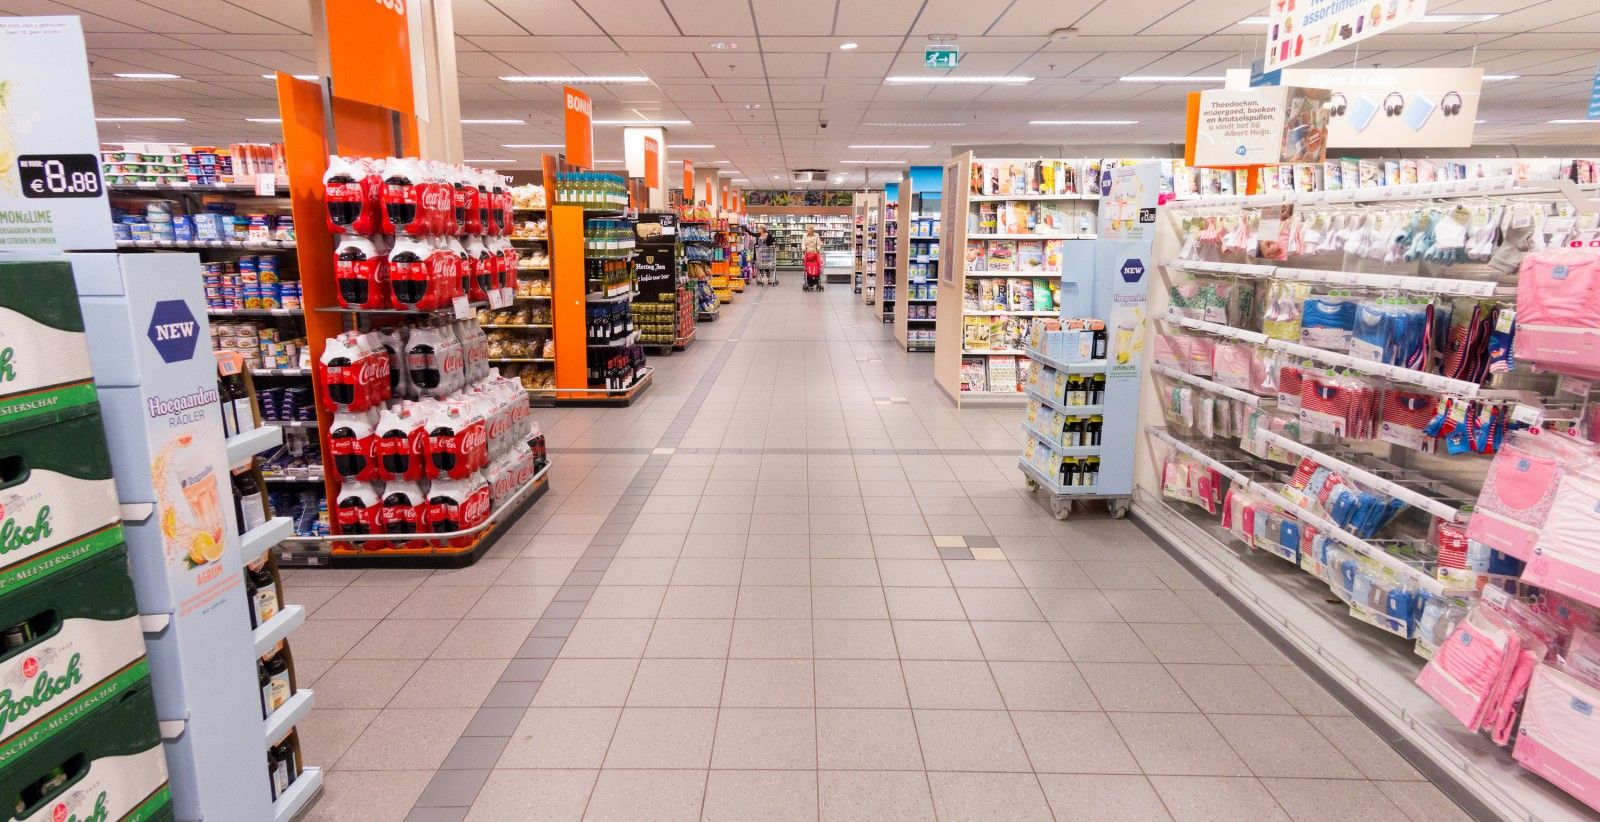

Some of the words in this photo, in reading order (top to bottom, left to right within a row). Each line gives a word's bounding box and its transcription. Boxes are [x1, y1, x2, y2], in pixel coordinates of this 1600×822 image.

[1247, 106, 1276, 114] boeken
[1215, 123, 1234, 131] vindt
[1236, 122, 1249, 130] het
[1251, 121, 1261, 130] bij
[634, 263, 654, 271] Hertog
[654, 263, 666, 271] Jan
[155, 321, 195, 341] NEW
[147, 386, 218, 418] Hoegaarden
[169, 409, 206, 428] RADLER
[16, 544, 92, 581] MEESTERSCHAP
[197, 563, 224, 587] AGRUM
[48, 682, 118, 730] MEESTERSCHAP
